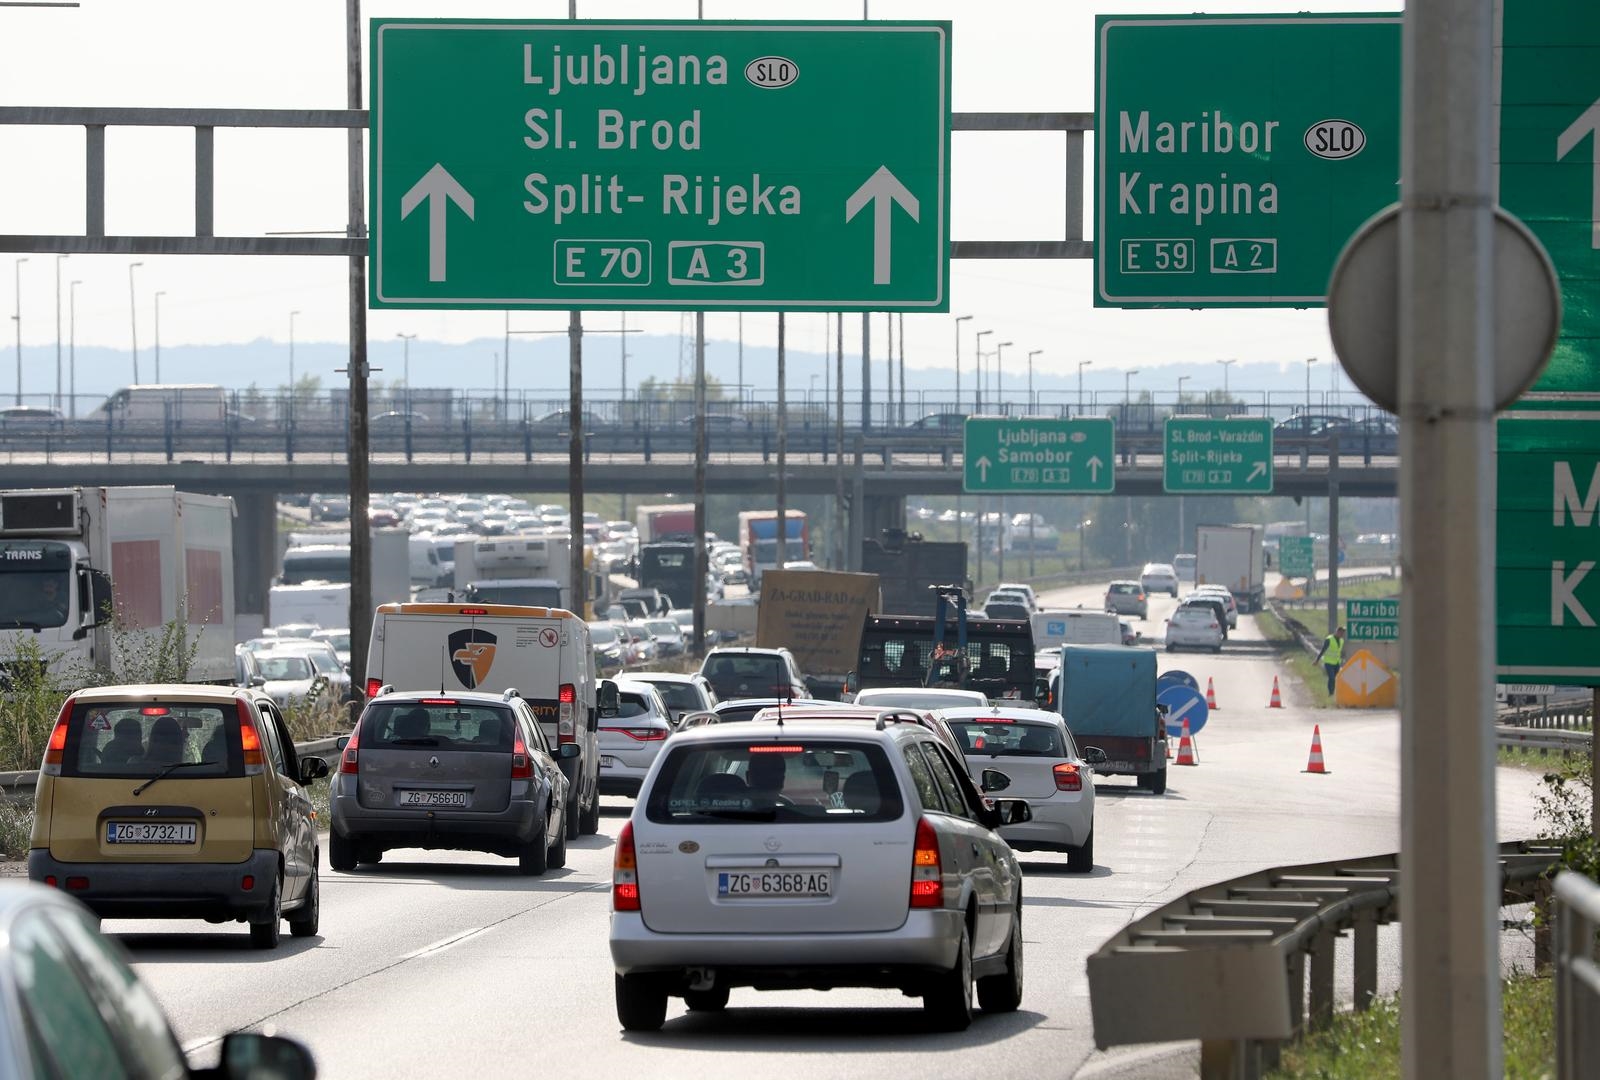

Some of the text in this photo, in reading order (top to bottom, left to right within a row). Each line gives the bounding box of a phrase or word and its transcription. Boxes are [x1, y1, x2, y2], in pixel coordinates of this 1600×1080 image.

[524, 43, 728, 96] Ljubljana
[756, 63, 790, 82] SLO
[523, 108, 701, 151] Sl. Brod
[1119, 110, 1280, 153] Maribor
[1315, 126, 1355, 153] SLO
[664, 173, 801, 226] Rijeka
[1119, 172, 1278, 226] Krapina
[566, 247, 642, 279] E 70
[686, 247, 748, 279] A 3
[1127, 242, 1188, 270] E 59
[1224, 244, 1263, 268] A 2
[998, 428, 1067, 447] Ljubljana
[998, 448, 1073, 464] Samobor
[5, 550, 43, 560] TRANS
[1351, 622, 1399, 640] Krapina
[407, 792, 420, 803] ZG
[117, 825, 134, 839] ZG
[730, 874, 751, 893] ZG
